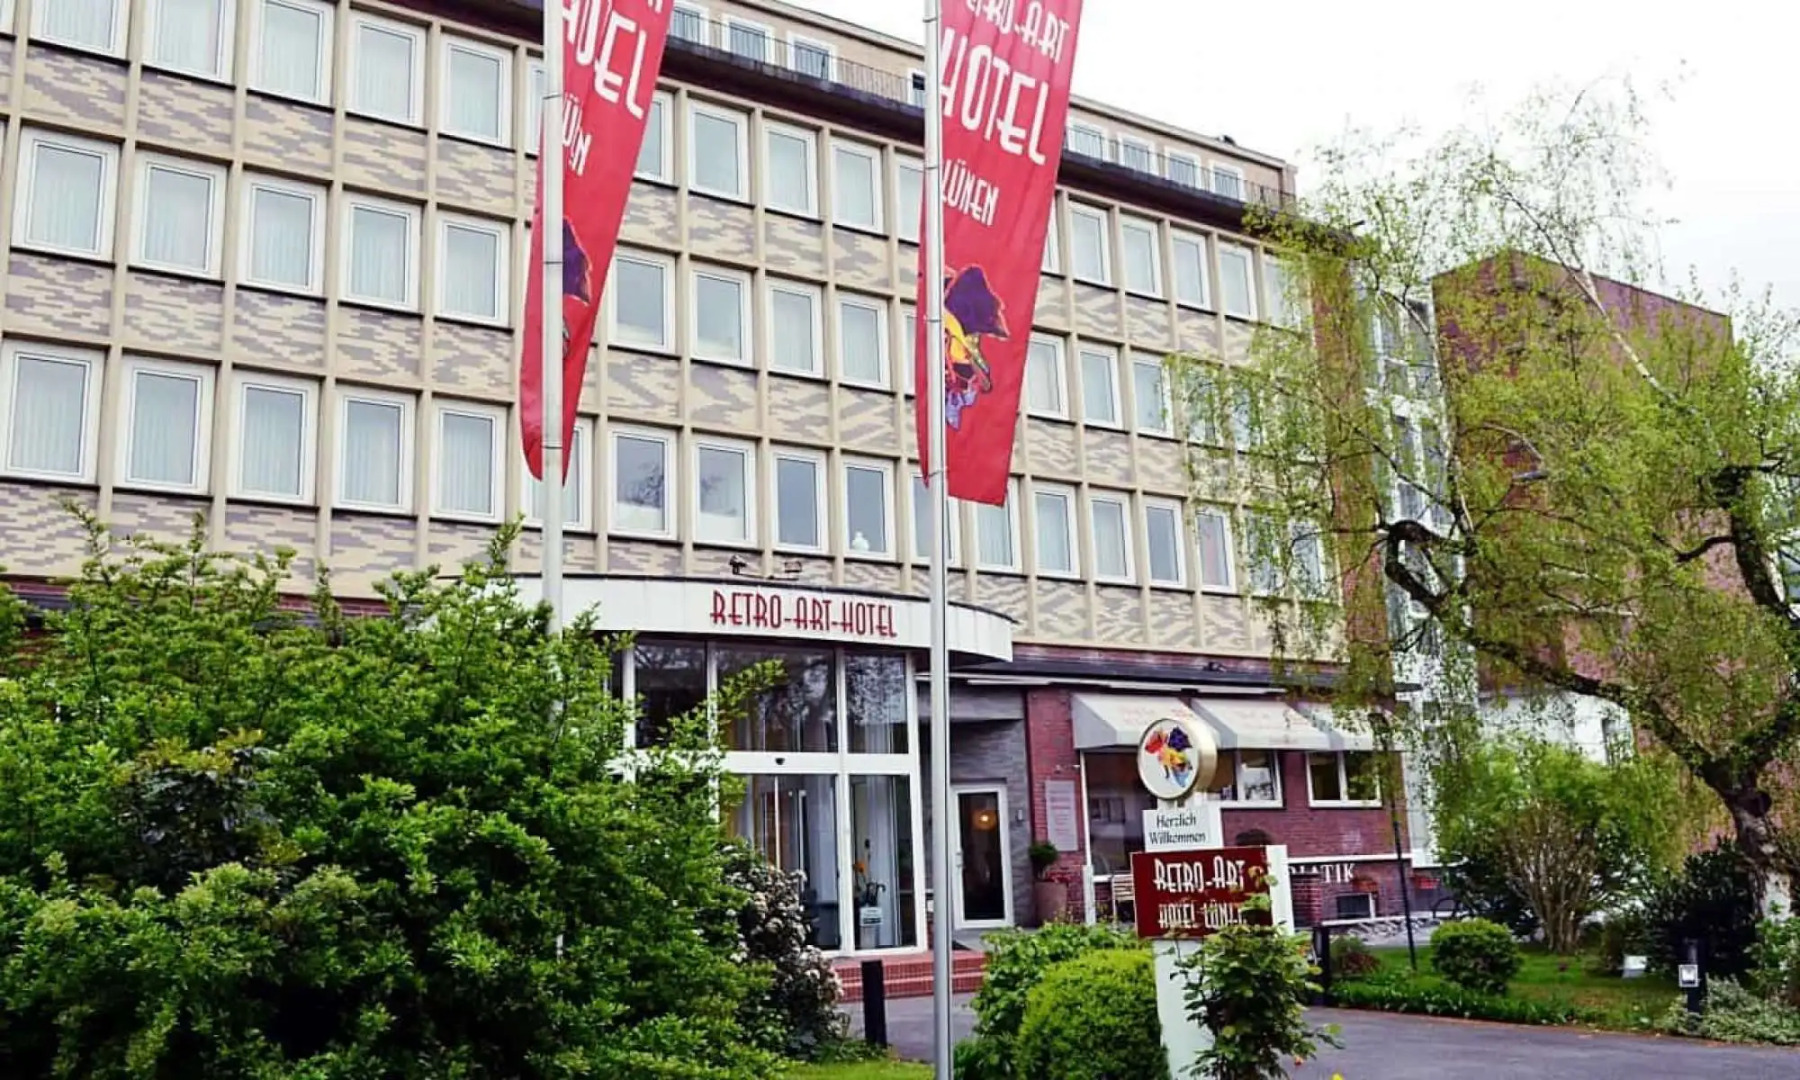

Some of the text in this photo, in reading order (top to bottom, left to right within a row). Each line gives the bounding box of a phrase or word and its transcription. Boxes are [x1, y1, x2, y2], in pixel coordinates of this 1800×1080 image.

[966, 0, 1070, 64] RO-ART
[940, 27, 1049, 165] HOTEL
[941, 158, 1000, 227] LÜNEN
[710, 590, 898, 638] RETRO-ART-HOTEL
[1149, 831, 1207, 845] Willkommen
[1156, 813, 1197, 829] Herzlich
